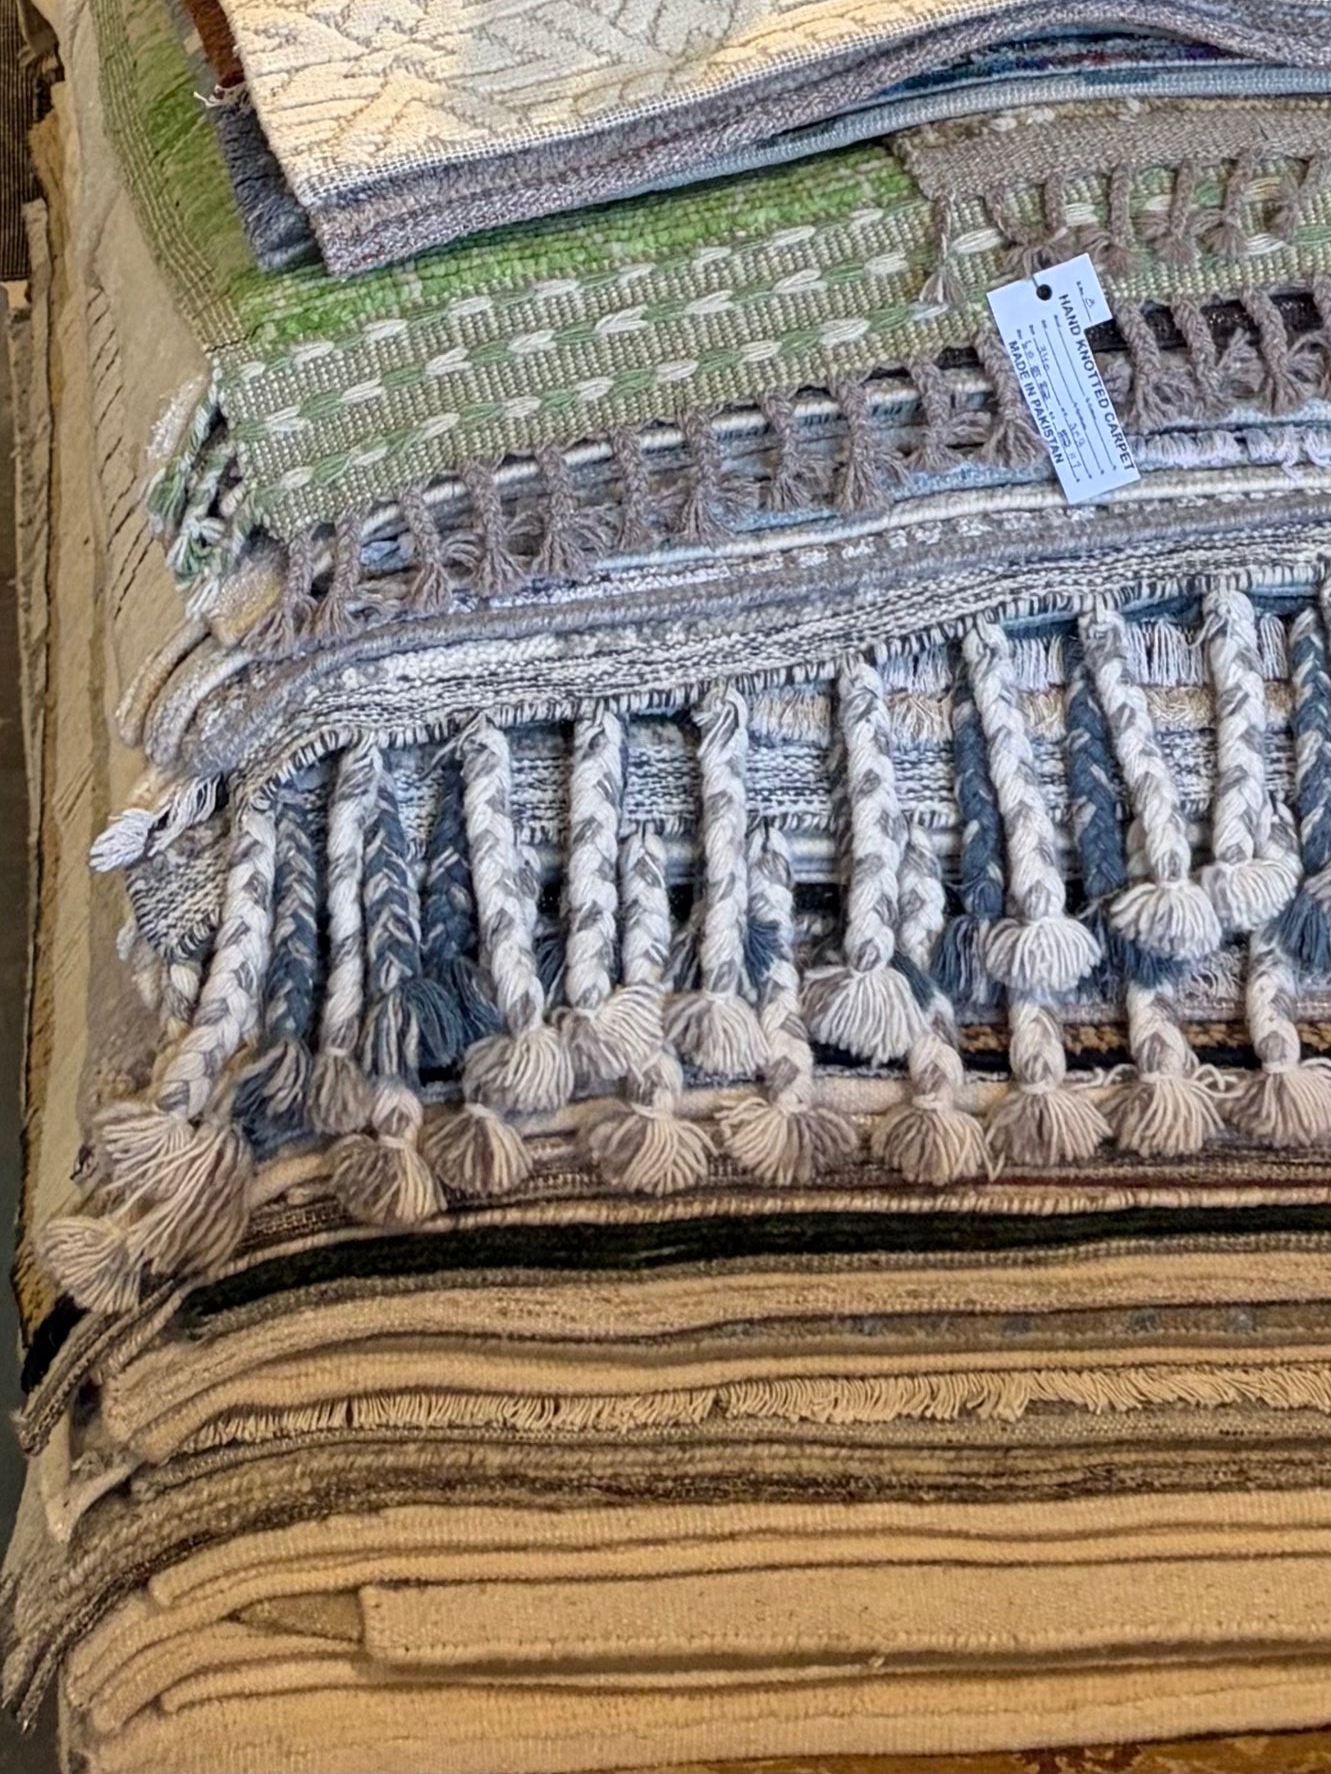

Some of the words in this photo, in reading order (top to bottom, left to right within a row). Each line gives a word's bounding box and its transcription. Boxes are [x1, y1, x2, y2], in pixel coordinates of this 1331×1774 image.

[1008, 340, 1027, 378] MADE
[1059, 293, 1081, 336] HAND
[1075, 340, 1109, 409] KNOTTED
[1104, 411, 1136, 471] CARPET
[1023, 381, 1037, 399] IN
[1029, 398, 1064, 464] PAKISTAN
